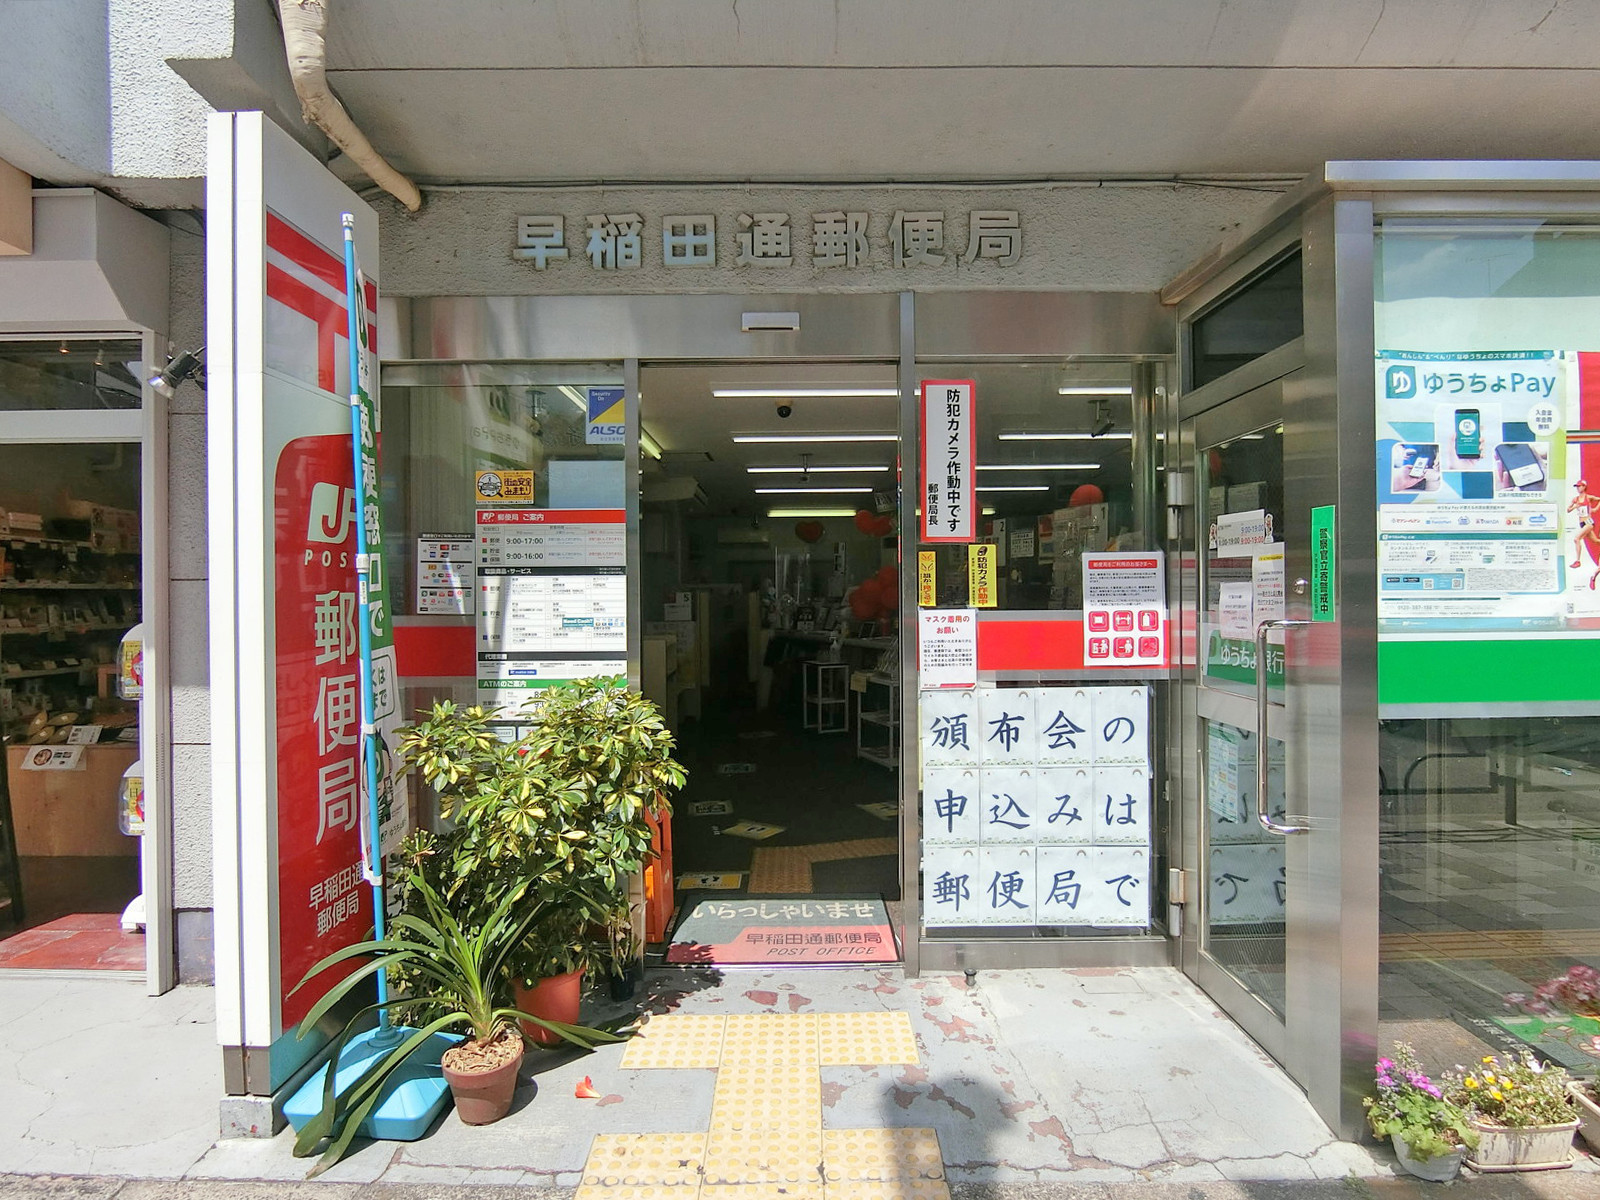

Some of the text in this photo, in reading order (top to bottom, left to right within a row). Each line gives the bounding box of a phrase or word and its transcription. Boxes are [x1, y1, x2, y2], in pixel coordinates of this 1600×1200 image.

[513, 210, 1023, 269] 早稲田通郵便局
[1423, 373, 1556, 398] ゆうちょPay
[589, 425, 625, 436] ALSO
[946, 389, 961, 532] 防犯カメラ作動中です
[522, 513, 545, 522] ご案内
[928, 483, 939, 526] 郵便局長
[506, 537, 544, 545] 9:00-17:00
[304, 549, 348, 567] POS
[977, 556, 988, 606] 防犯カメラ作動中
[925, 615, 970, 623] マスク着用の
[936, 626, 959, 634] お願い
[313, 590, 358, 846] 郵便局
[930, 710, 1136, 752] 頒布会の
[934, 788, 1138, 833] 申込みは
[309, 860, 364, 911] 早稲田通
[932, 869, 1140, 912] 郵便局で
[317, 889, 359, 938] 郵便局
[692, 902, 875, 919] いらっしゃいませ
[745, 932, 882, 945] 早稲田通郵便局
[767, 946, 876, 956] POST OFFICE
